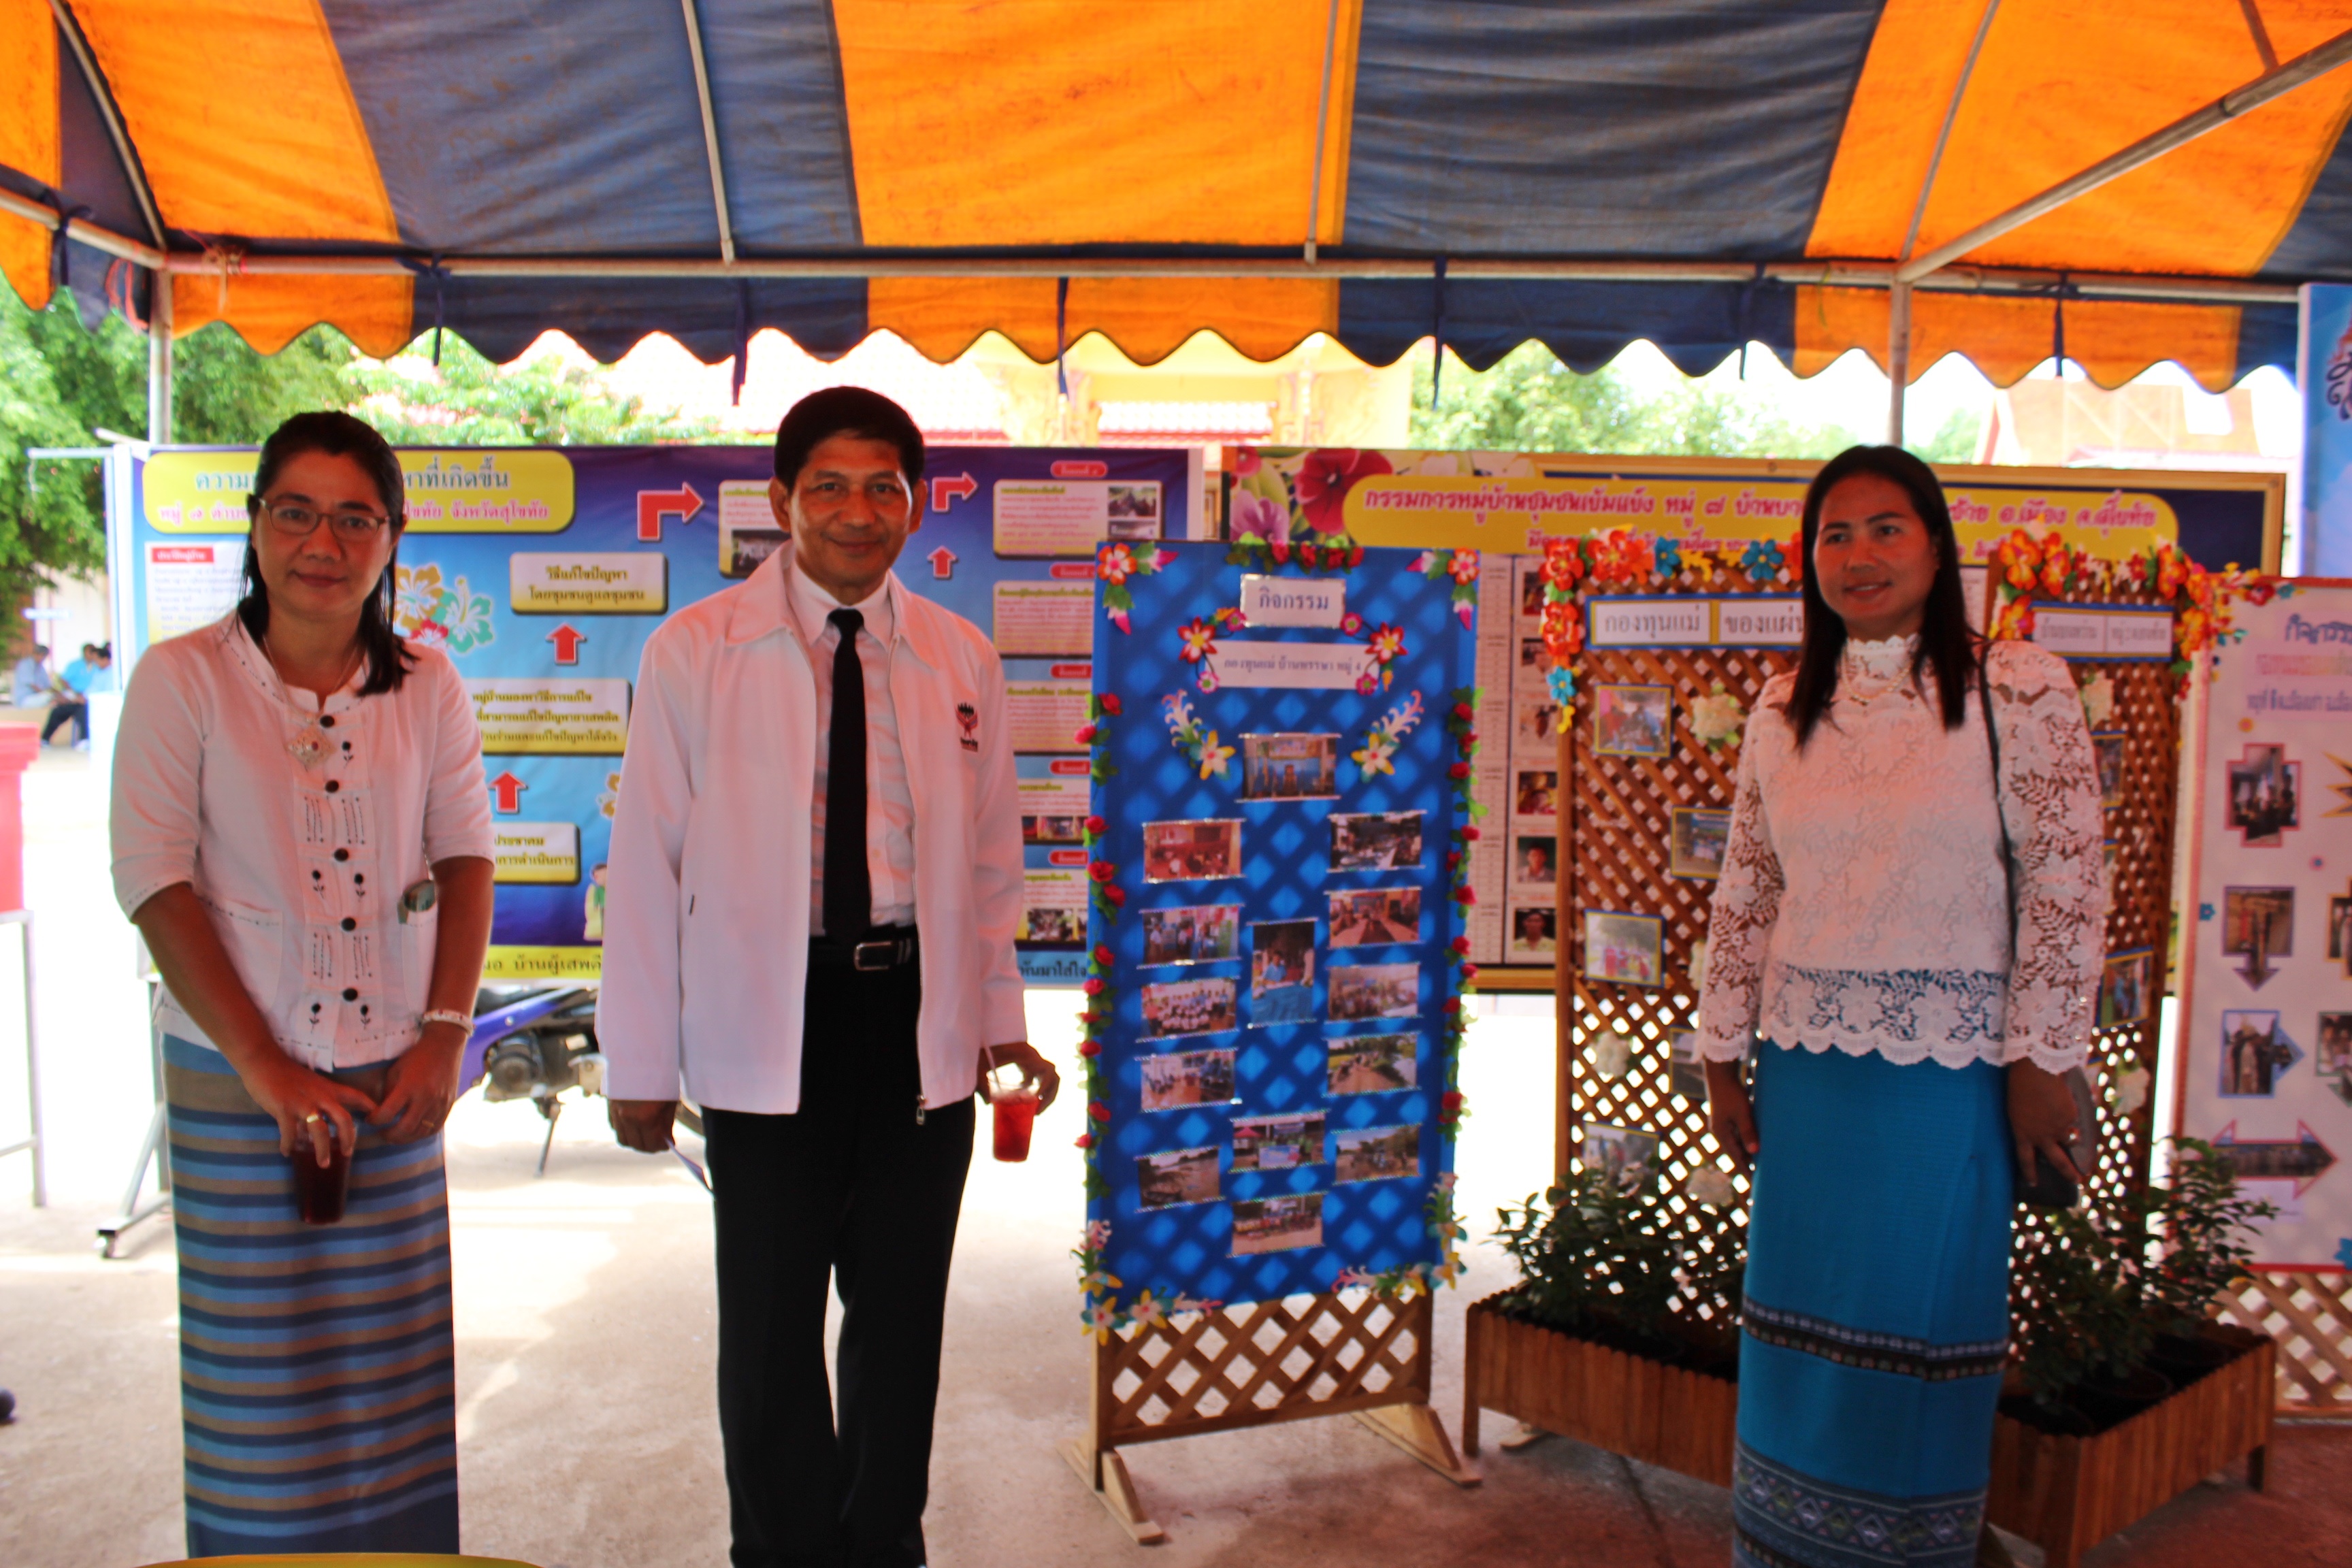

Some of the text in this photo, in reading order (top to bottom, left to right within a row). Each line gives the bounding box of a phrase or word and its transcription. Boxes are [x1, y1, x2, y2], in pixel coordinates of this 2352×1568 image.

[1664, 488, 1696, 529] หมู่
[1259, 585, 1329, 609] กิจกรรม
[1604, 604, 1701, 638] กองทุนแม่
